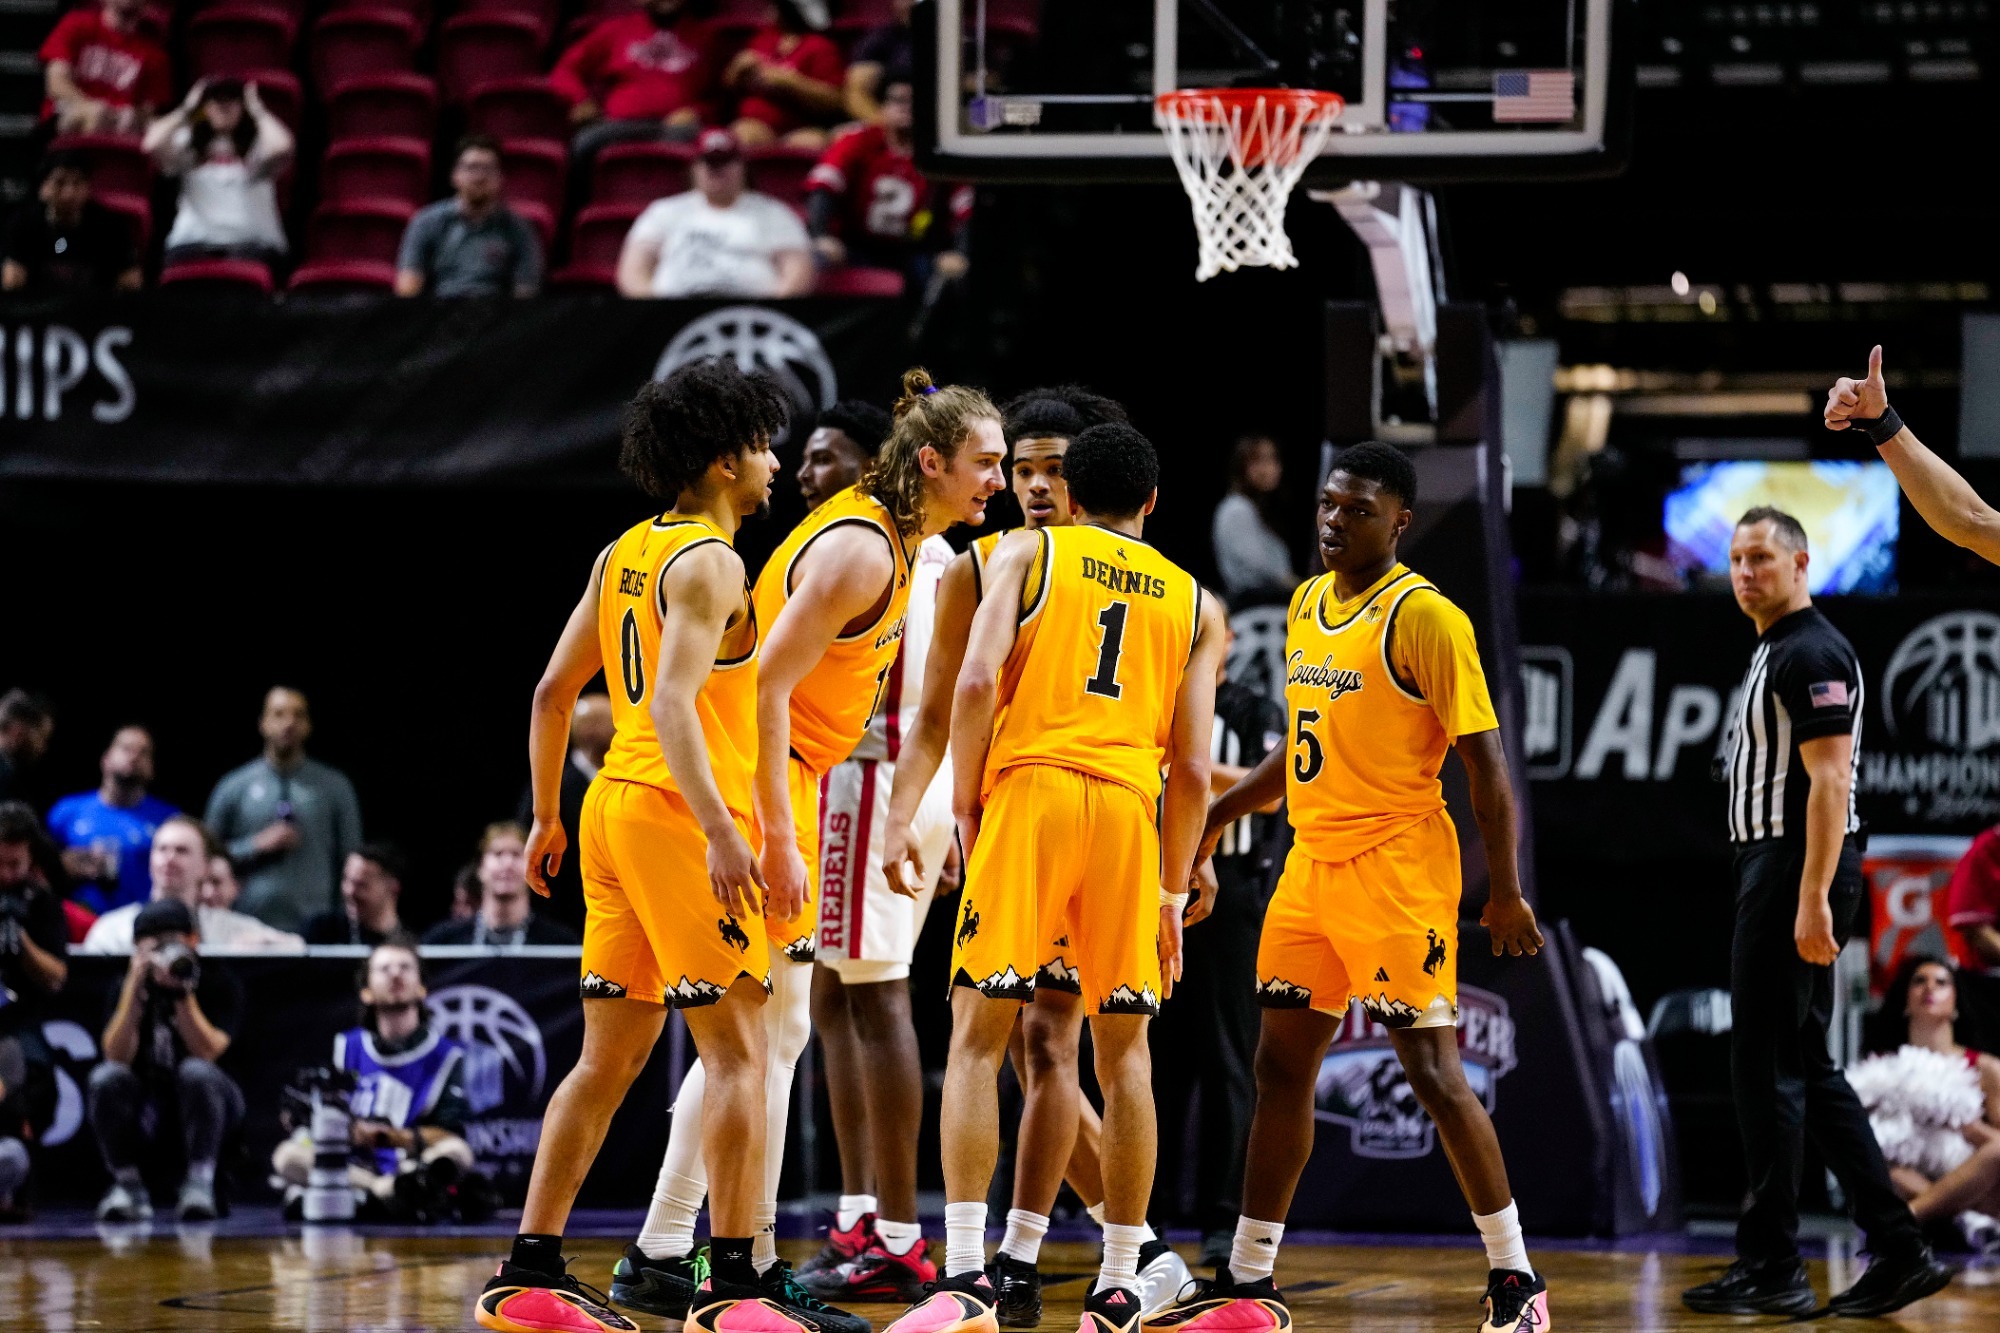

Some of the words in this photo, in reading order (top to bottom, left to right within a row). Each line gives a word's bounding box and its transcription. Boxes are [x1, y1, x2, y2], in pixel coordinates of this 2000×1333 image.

[867, 174, 915, 236] 2
[1081, 556, 1166, 599] DENNIS
[619, 605, 646, 707] 0
[1084, 599, 1130, 701] 1
[1287, 648, 1364, 702] Cowboys
[1294, 707, 1326, 785] 5
[820, 811, 852, 950] REBELS
[1887, 876, 1932, 927] G
